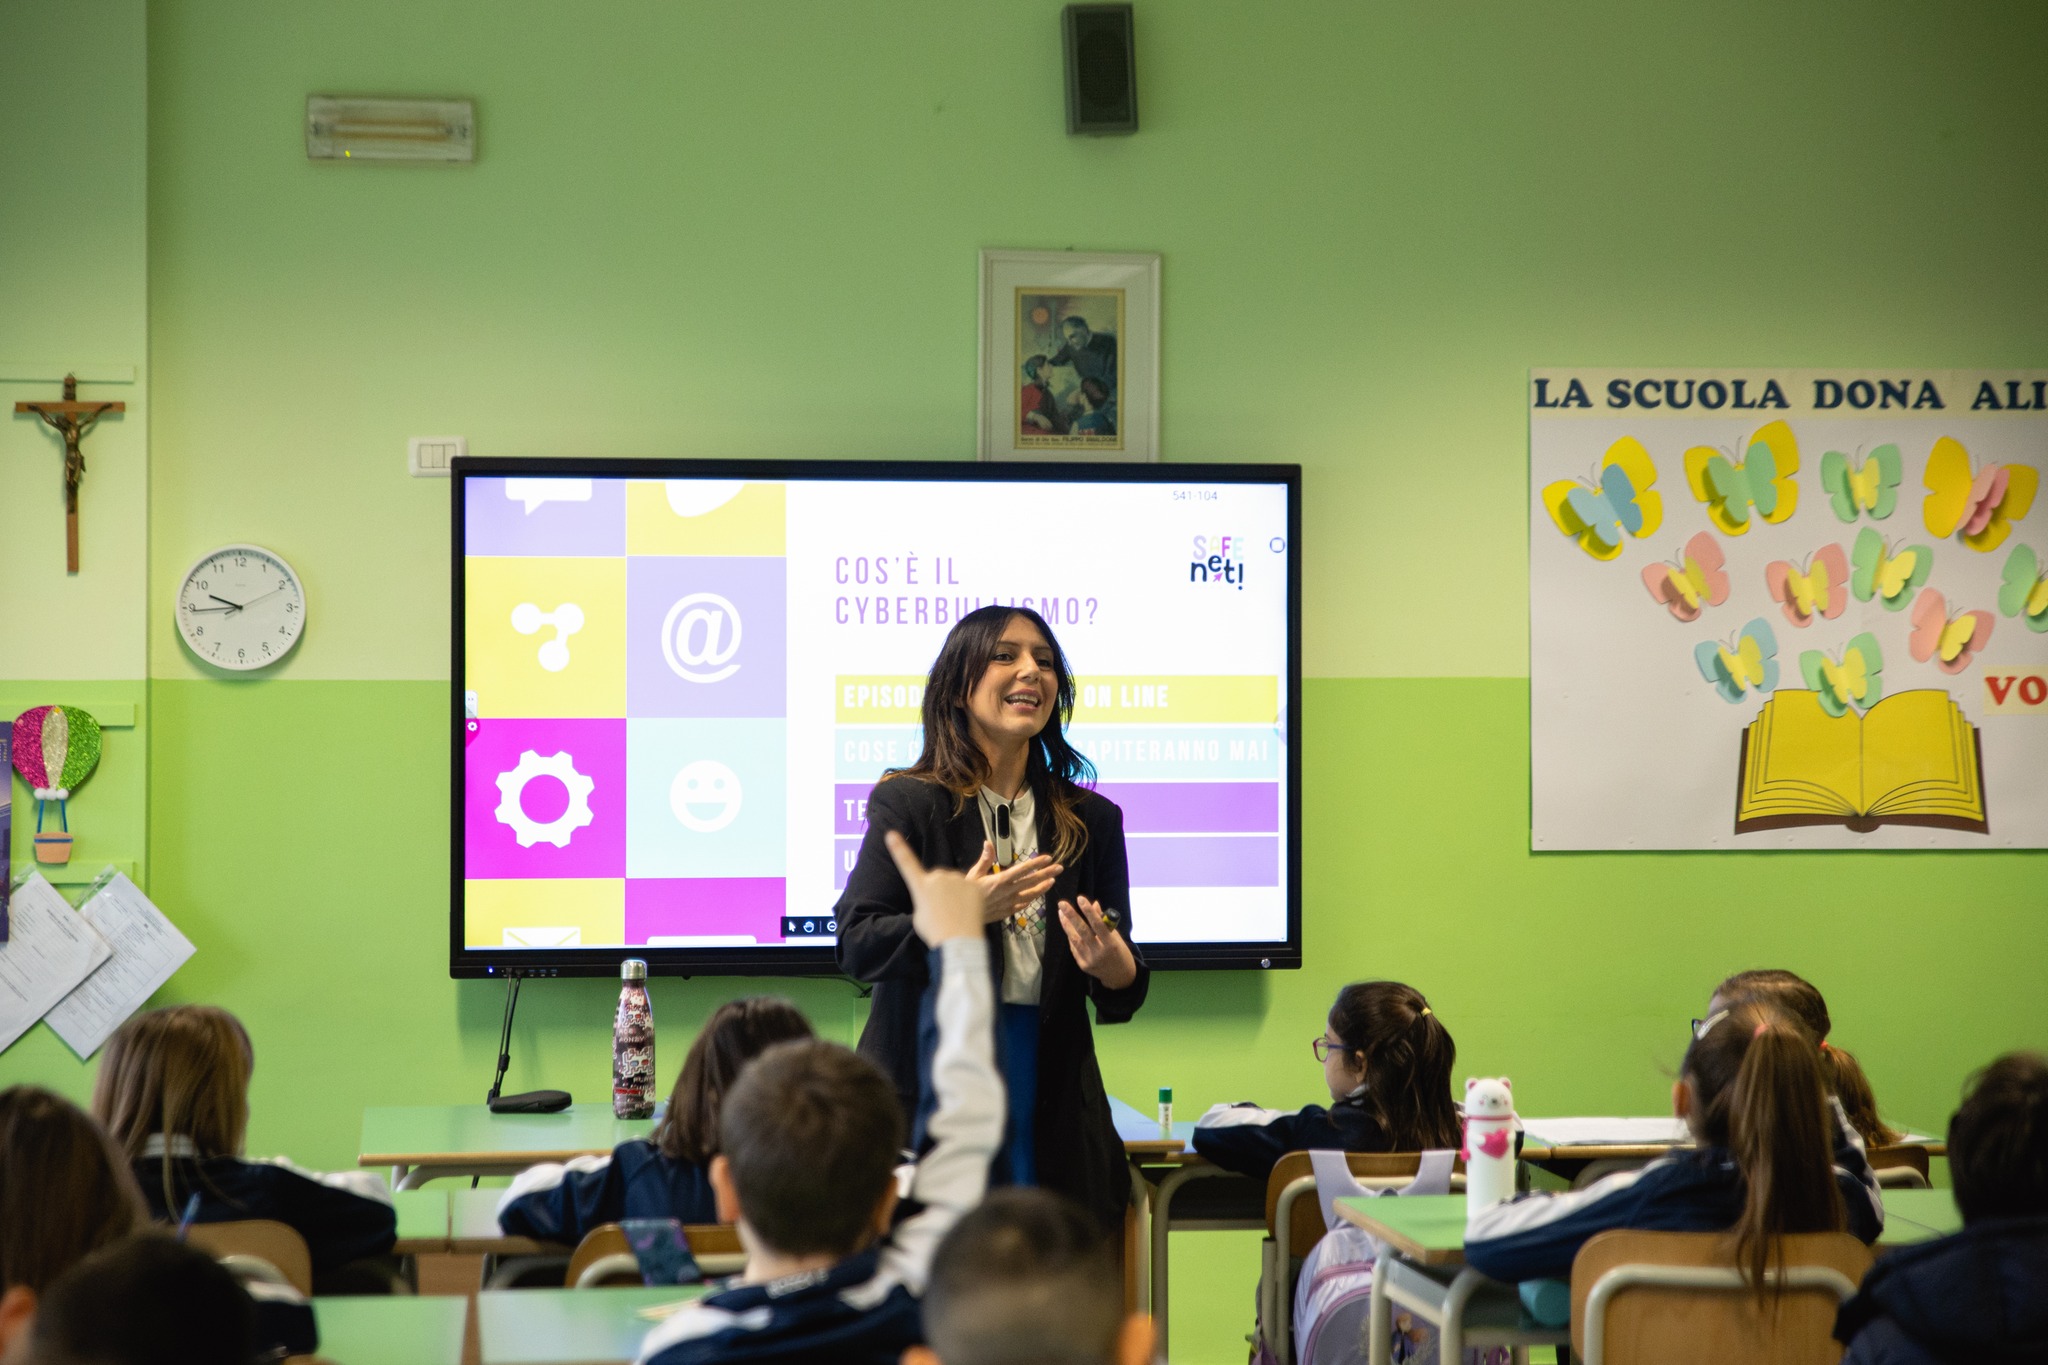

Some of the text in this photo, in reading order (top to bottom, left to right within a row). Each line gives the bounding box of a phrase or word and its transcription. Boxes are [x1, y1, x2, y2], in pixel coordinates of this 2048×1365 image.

[1533, 378, 2048, 410] LA SCUOLA DONA ALI
[1172, 490, 1218, 501] 541-104
[1192, 534, 1245, 561] SAFE
[212, 563, 225, 573] 11
[233, 557, 247, 568] 12
[261, 563, 267, 573] 1
[936, 557, 960, 585] IL
[1190, 554, 1244, 591] net!
[195, 580, 209, 591] 10
[278, 579, 286, 590] 2
[188, 603, 196, 613] 9
[285, 603, 293, 613] 3
[196, 626, 204, 636] 8
[278, 625, 286, 636] 4
[214, 642, 222, 652] 7
[261, 641, 269, 652] 5
[237, 648, 245, 658] 6
[843, 684, 1169, 708] EPISOD ON LINE
[1985, 675, 2048, 706] VO
[843, 740, 897, 763] COSE
[1230, 739, 1269, 762] MAI
